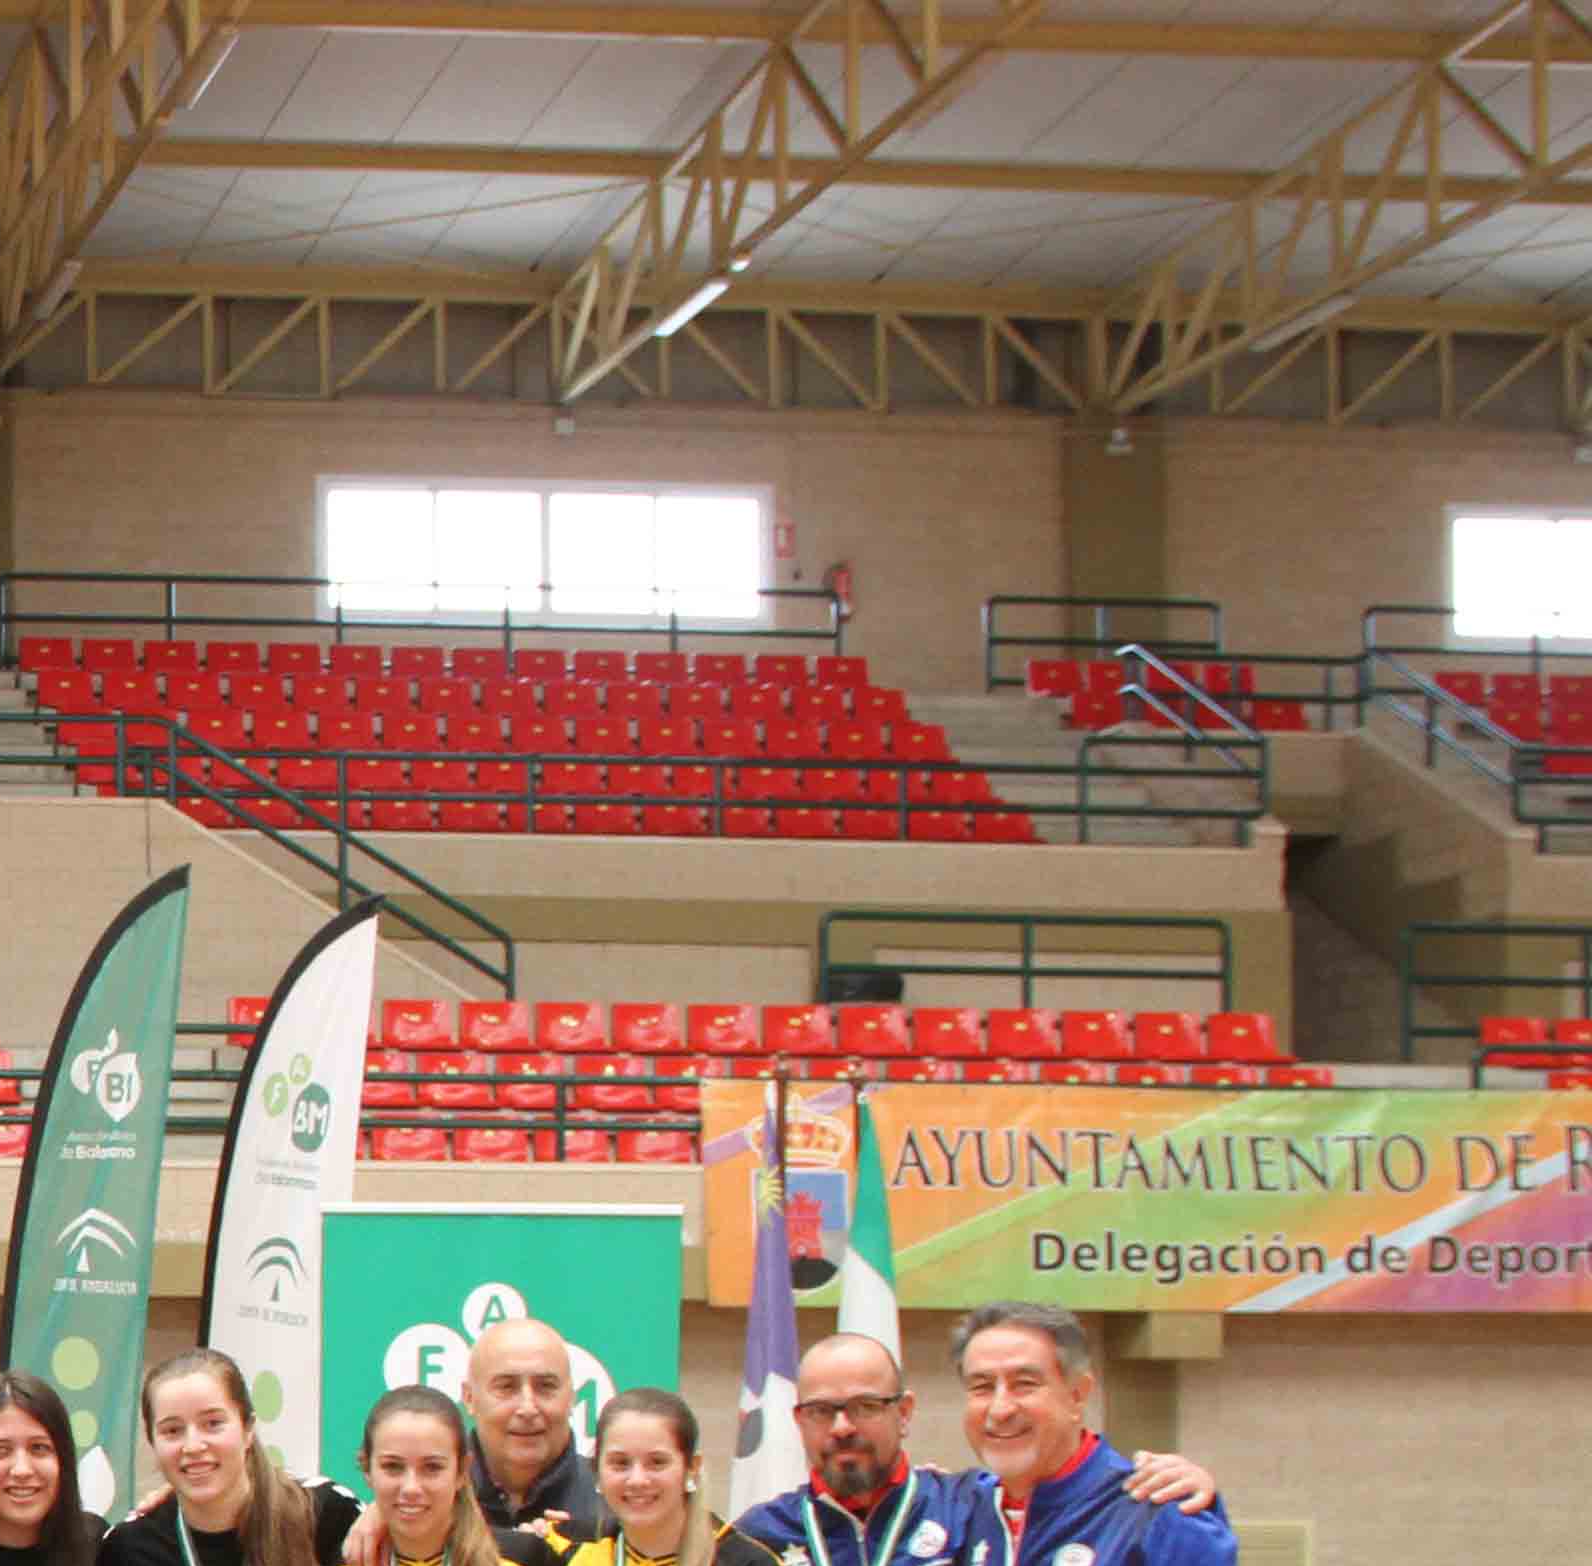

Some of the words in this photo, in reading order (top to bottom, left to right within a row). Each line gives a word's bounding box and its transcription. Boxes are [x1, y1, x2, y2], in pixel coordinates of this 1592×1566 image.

[891, 1128, 1427, 1193] AYUNTAMIENTO
[1453, 1134, 1538, 1192] DE
[1032, 1230, 1328, 1284] Delegación
[1345, 1235, 1410, 1274] de
